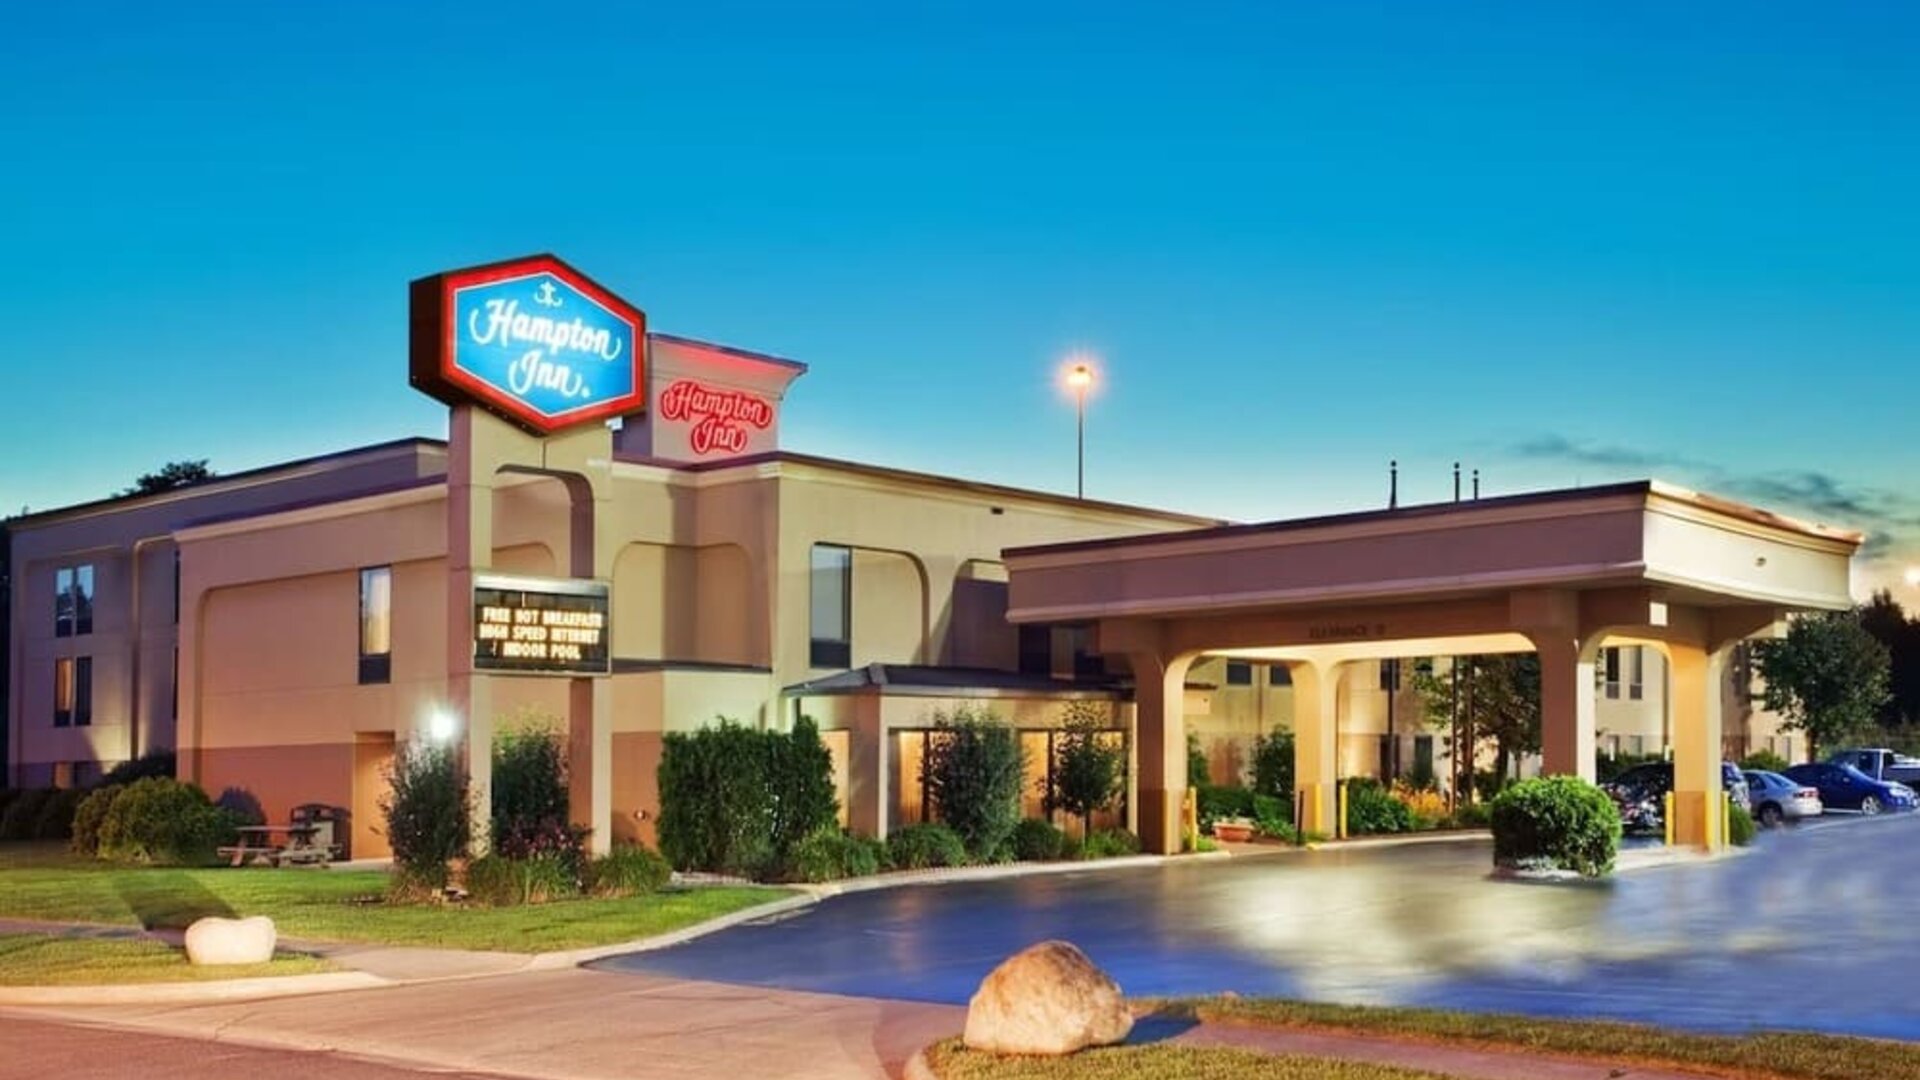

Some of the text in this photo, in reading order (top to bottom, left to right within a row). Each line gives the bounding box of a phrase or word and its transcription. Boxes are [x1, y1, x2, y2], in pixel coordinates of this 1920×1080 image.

[469, 299, 622, 361] Hampton
[508, 350, 583, 397] Inn
[662, 381, 772, 428] Hampton
[692, 418, 747, 453] Inn
[483, 606, 510, 623] FREE
[515, 609, 539, 624] HOT
[479, 623, 599, 644] HIGH SPEED INTERNET
[503, 641, 580, 660] INDOOR POOL
